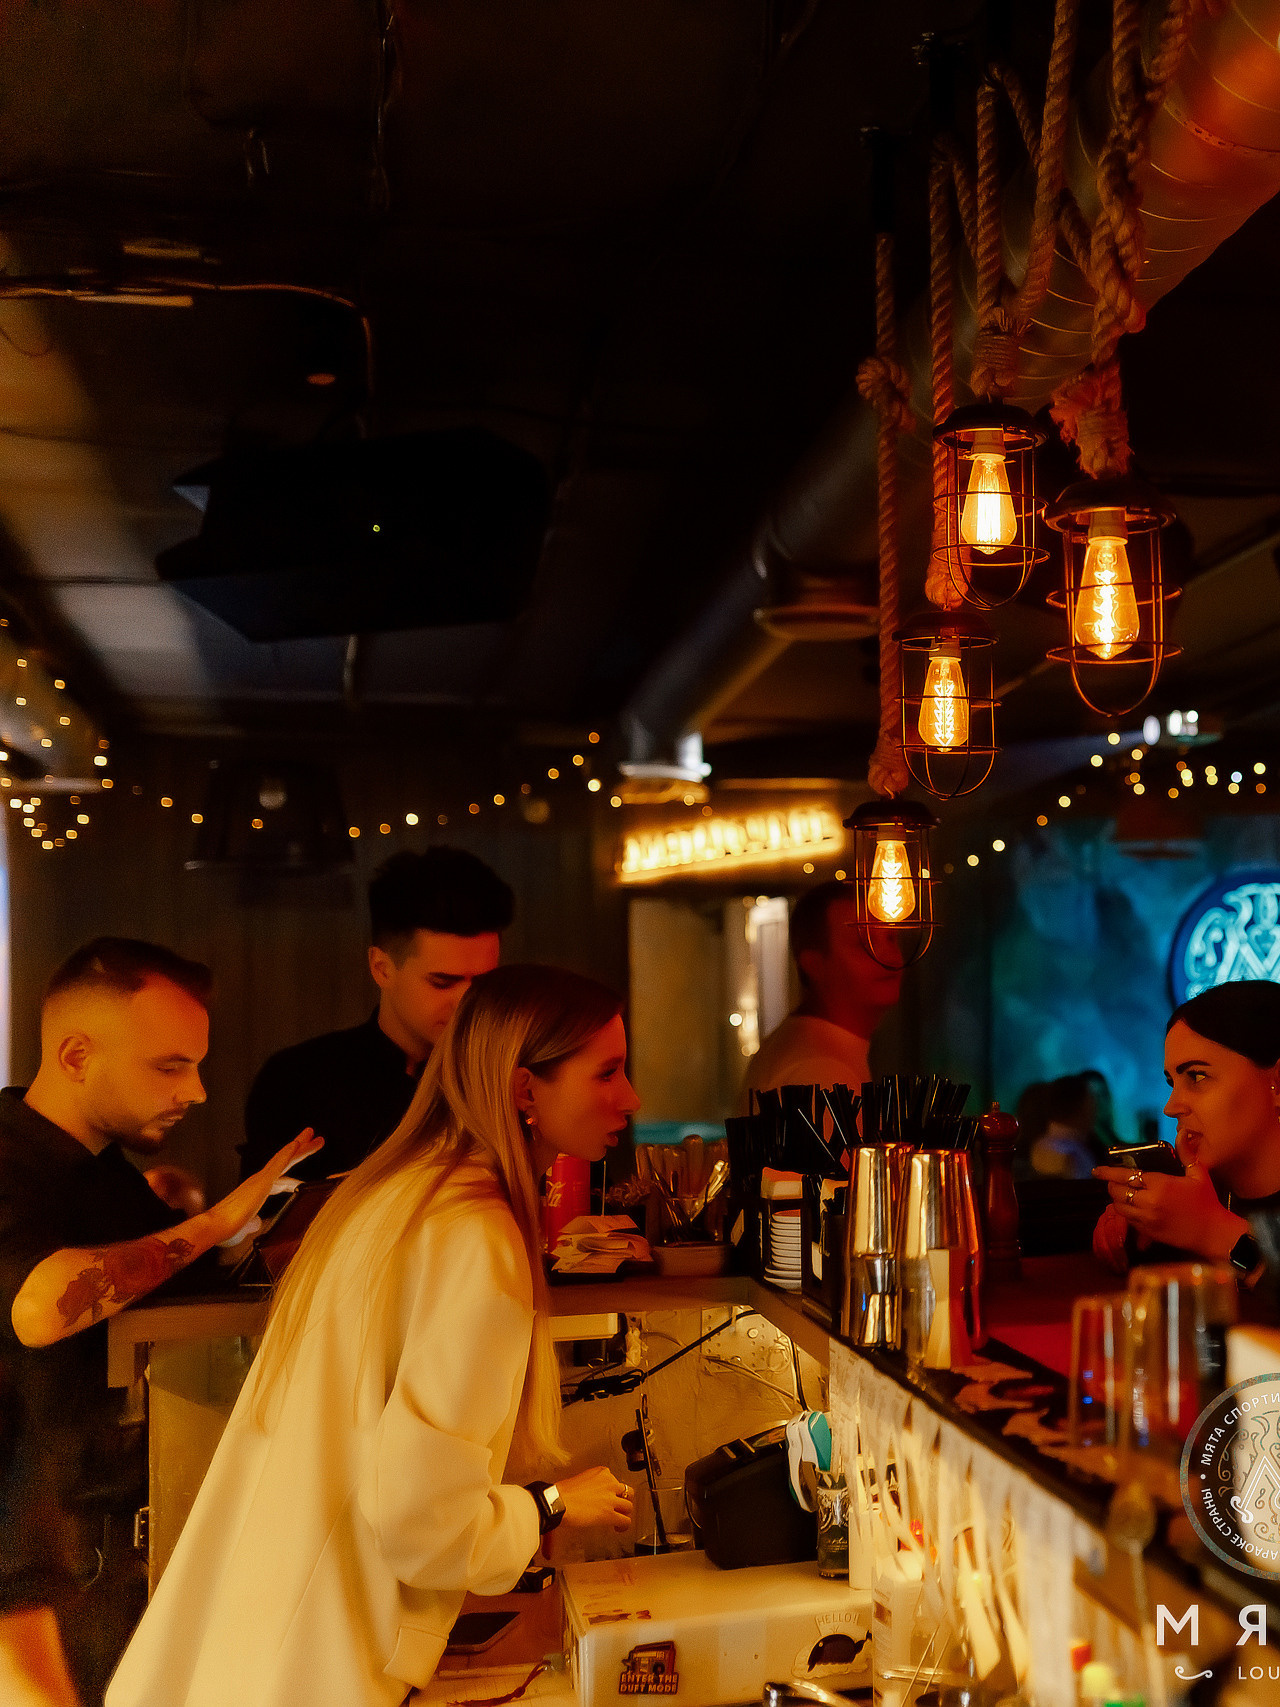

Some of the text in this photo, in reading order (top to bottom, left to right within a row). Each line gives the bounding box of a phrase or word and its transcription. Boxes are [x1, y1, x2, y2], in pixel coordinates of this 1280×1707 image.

[621, 1673, 678, 1683] ENTER THE
[648, 1684, 677, 1693] MODE
